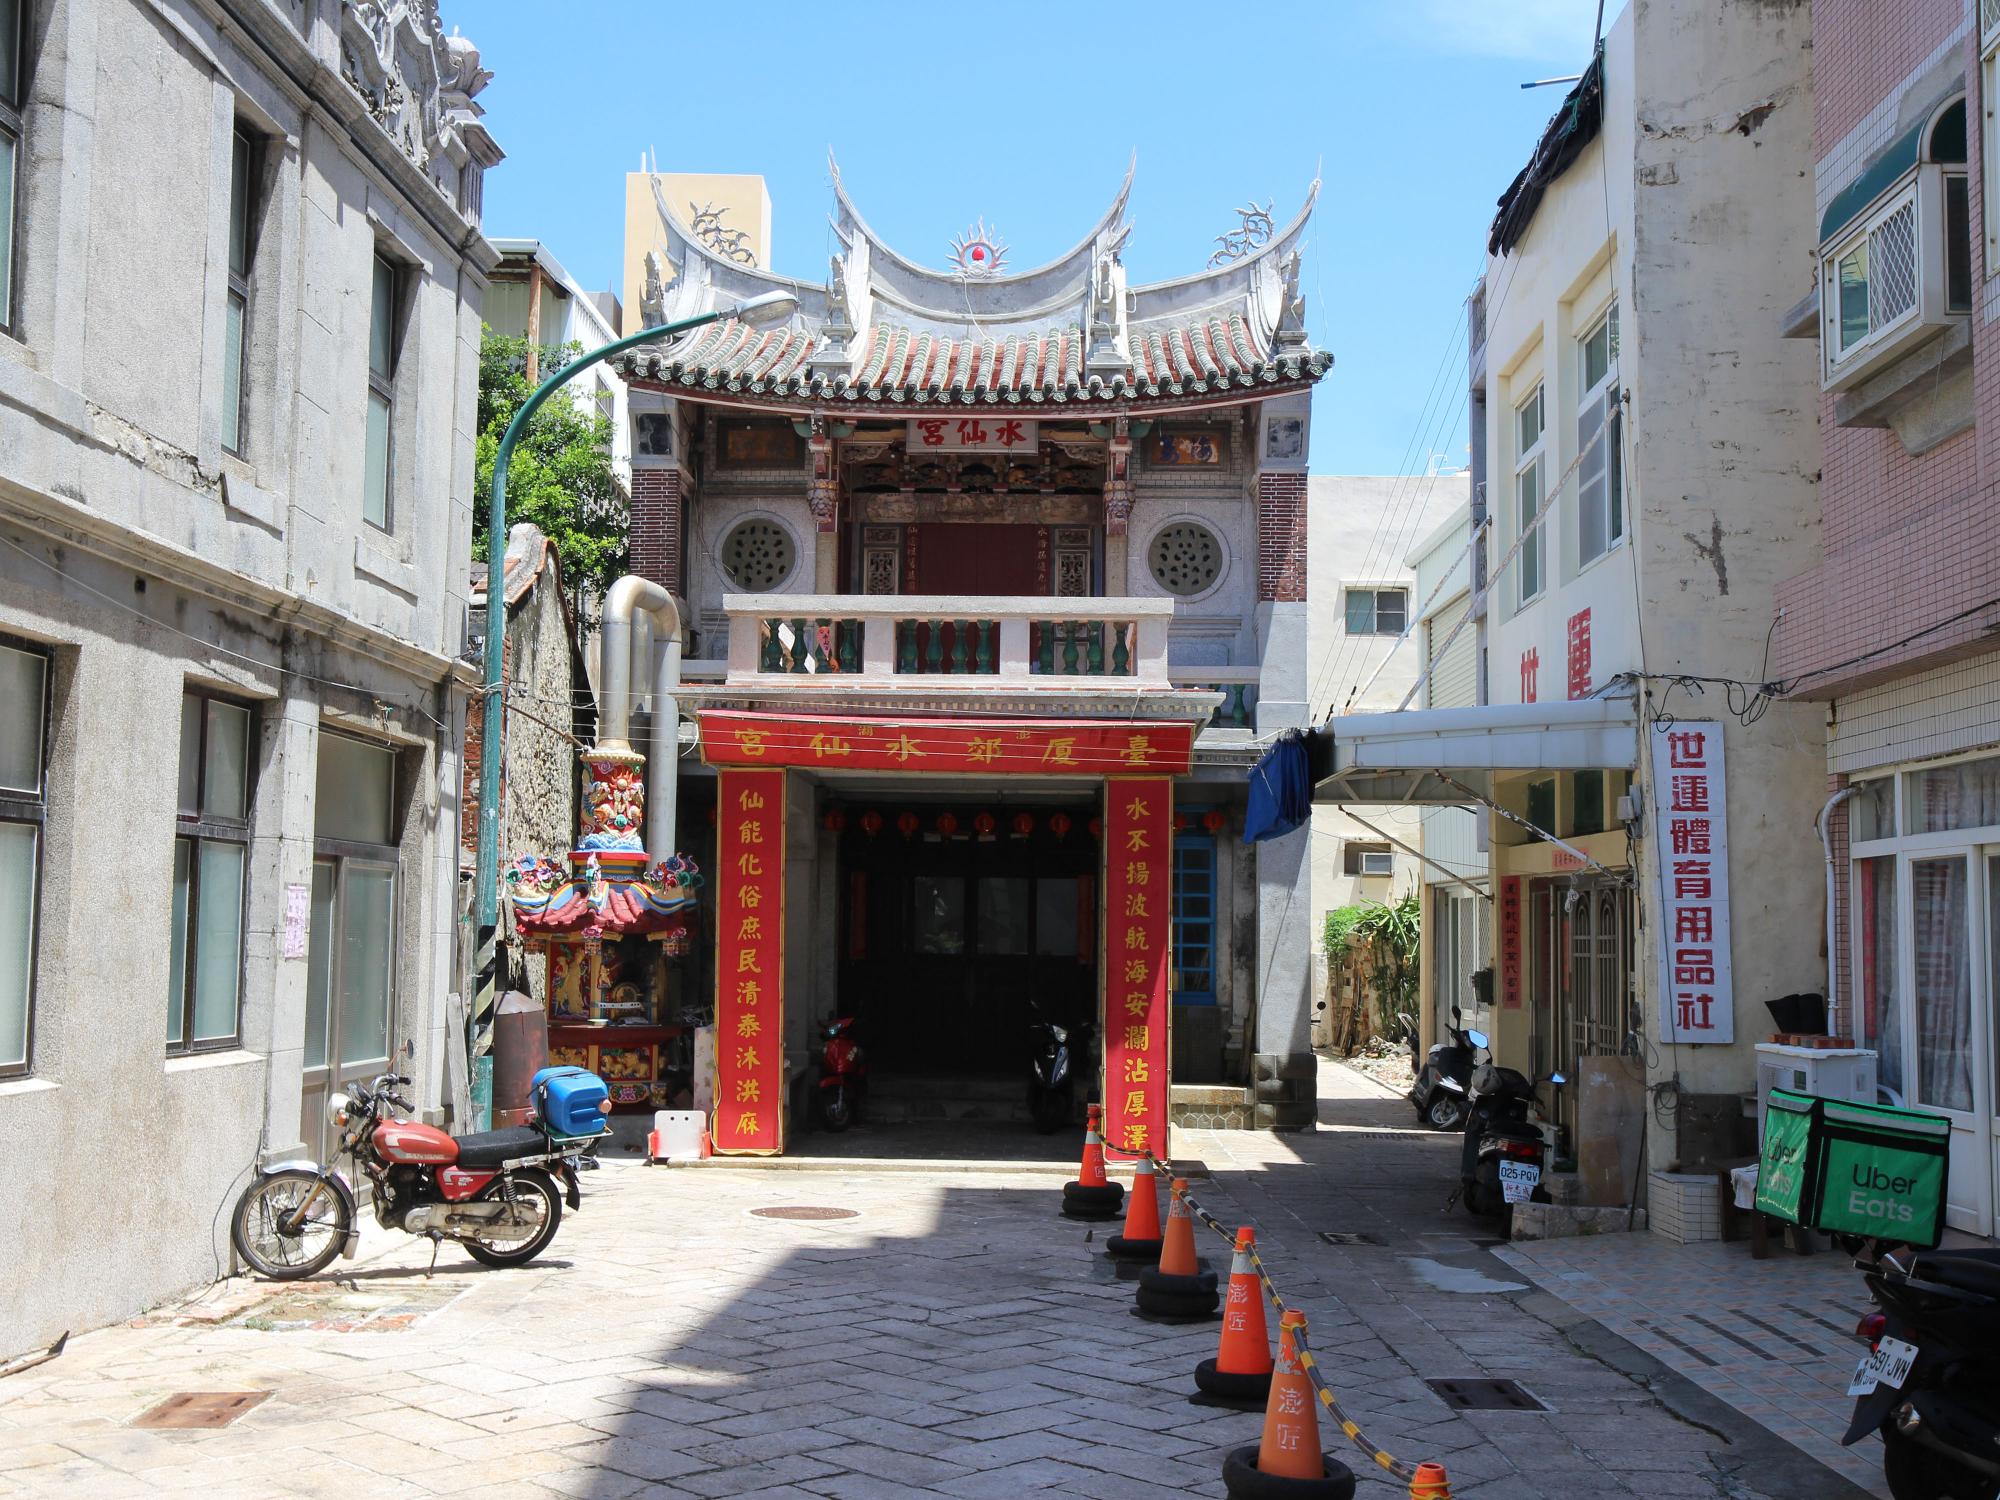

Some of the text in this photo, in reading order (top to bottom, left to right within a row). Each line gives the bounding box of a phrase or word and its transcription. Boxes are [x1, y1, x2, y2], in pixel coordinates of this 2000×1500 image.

[916, 419, 1027, 447] 水仙宮
[1668, 731, 1715, 1030] 世運體育用品社
[736, 789, 763, 1135] 仙能化俗庶民清泰沐洪庥
[1123, 797, 1151, 1150] 水不揚波航海安瀾沾厚澤
[1767, 1136, 1797, 1166] Uber
[1762, 1166, 1792, 1195] Eats
[1852, 1164, 1917, 1195] Uber
[1848, 1191, 1913, 1222] Eats
[1228, 1283, 1248, 1331] 澎匠
[1869, 1349, 1910, 1381] 591-JVN
[1277, 1387, 1304, 1450] 澎匠
